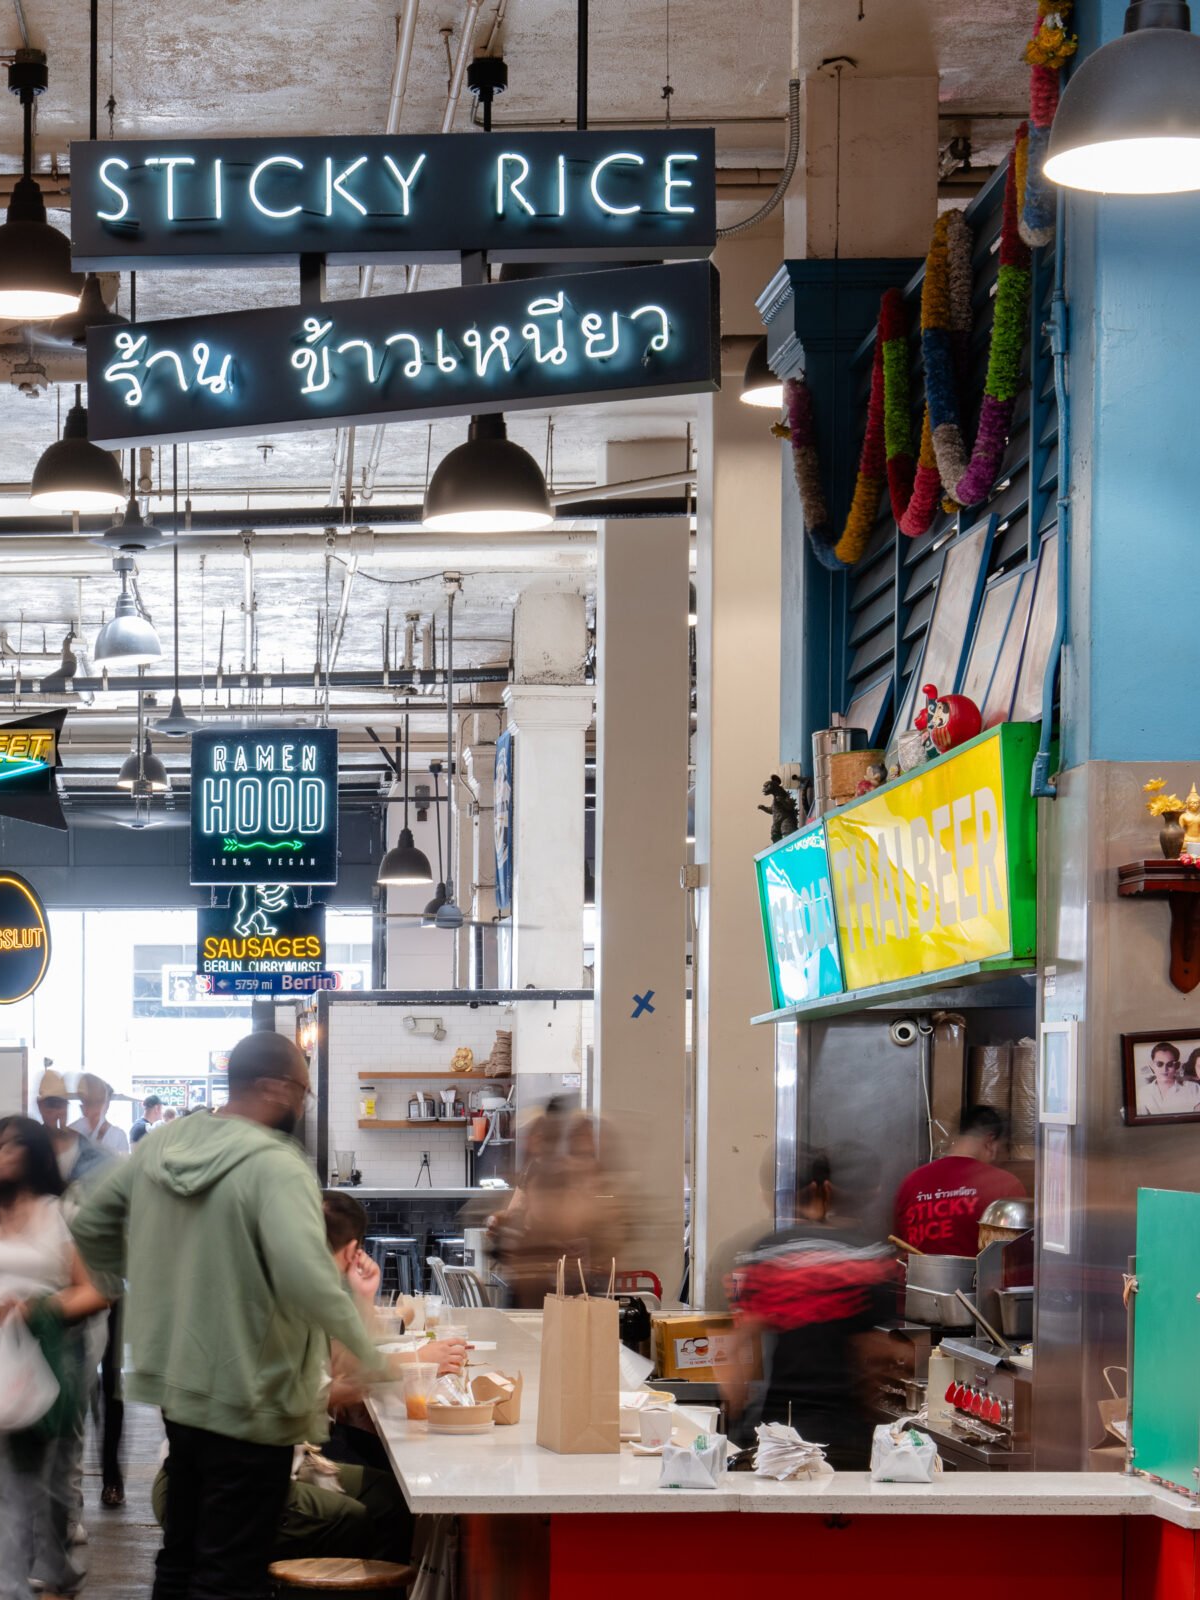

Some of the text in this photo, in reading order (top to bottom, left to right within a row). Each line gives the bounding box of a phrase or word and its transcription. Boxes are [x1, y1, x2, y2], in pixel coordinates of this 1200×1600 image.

[96, 152, 699, 221] STICKY RICE
[104, 290, 672, 408] ร้าน ข้าวเหนียว
[213, 745, 316, 772] RAMEN
[203, 777, 325, 834] HOOD
[212, 858, 316, 866] 100% VEGAN
[834, 787, 1004, 954] THAI BEER
[203, 936, 321, 959] SAUSAGES
[204, 960, 322, 973] BERLIN CURRYWURST
[235, 980, 258, 990] 5759
[262, 979, 273, 990] mi
[281, 975, 333, 990] Berlin
[144, 1086, 185, 1096] CIGARS
[906, 1196, 979, 1223] STICKY
[907, 1219, 953, 1244] RICE
